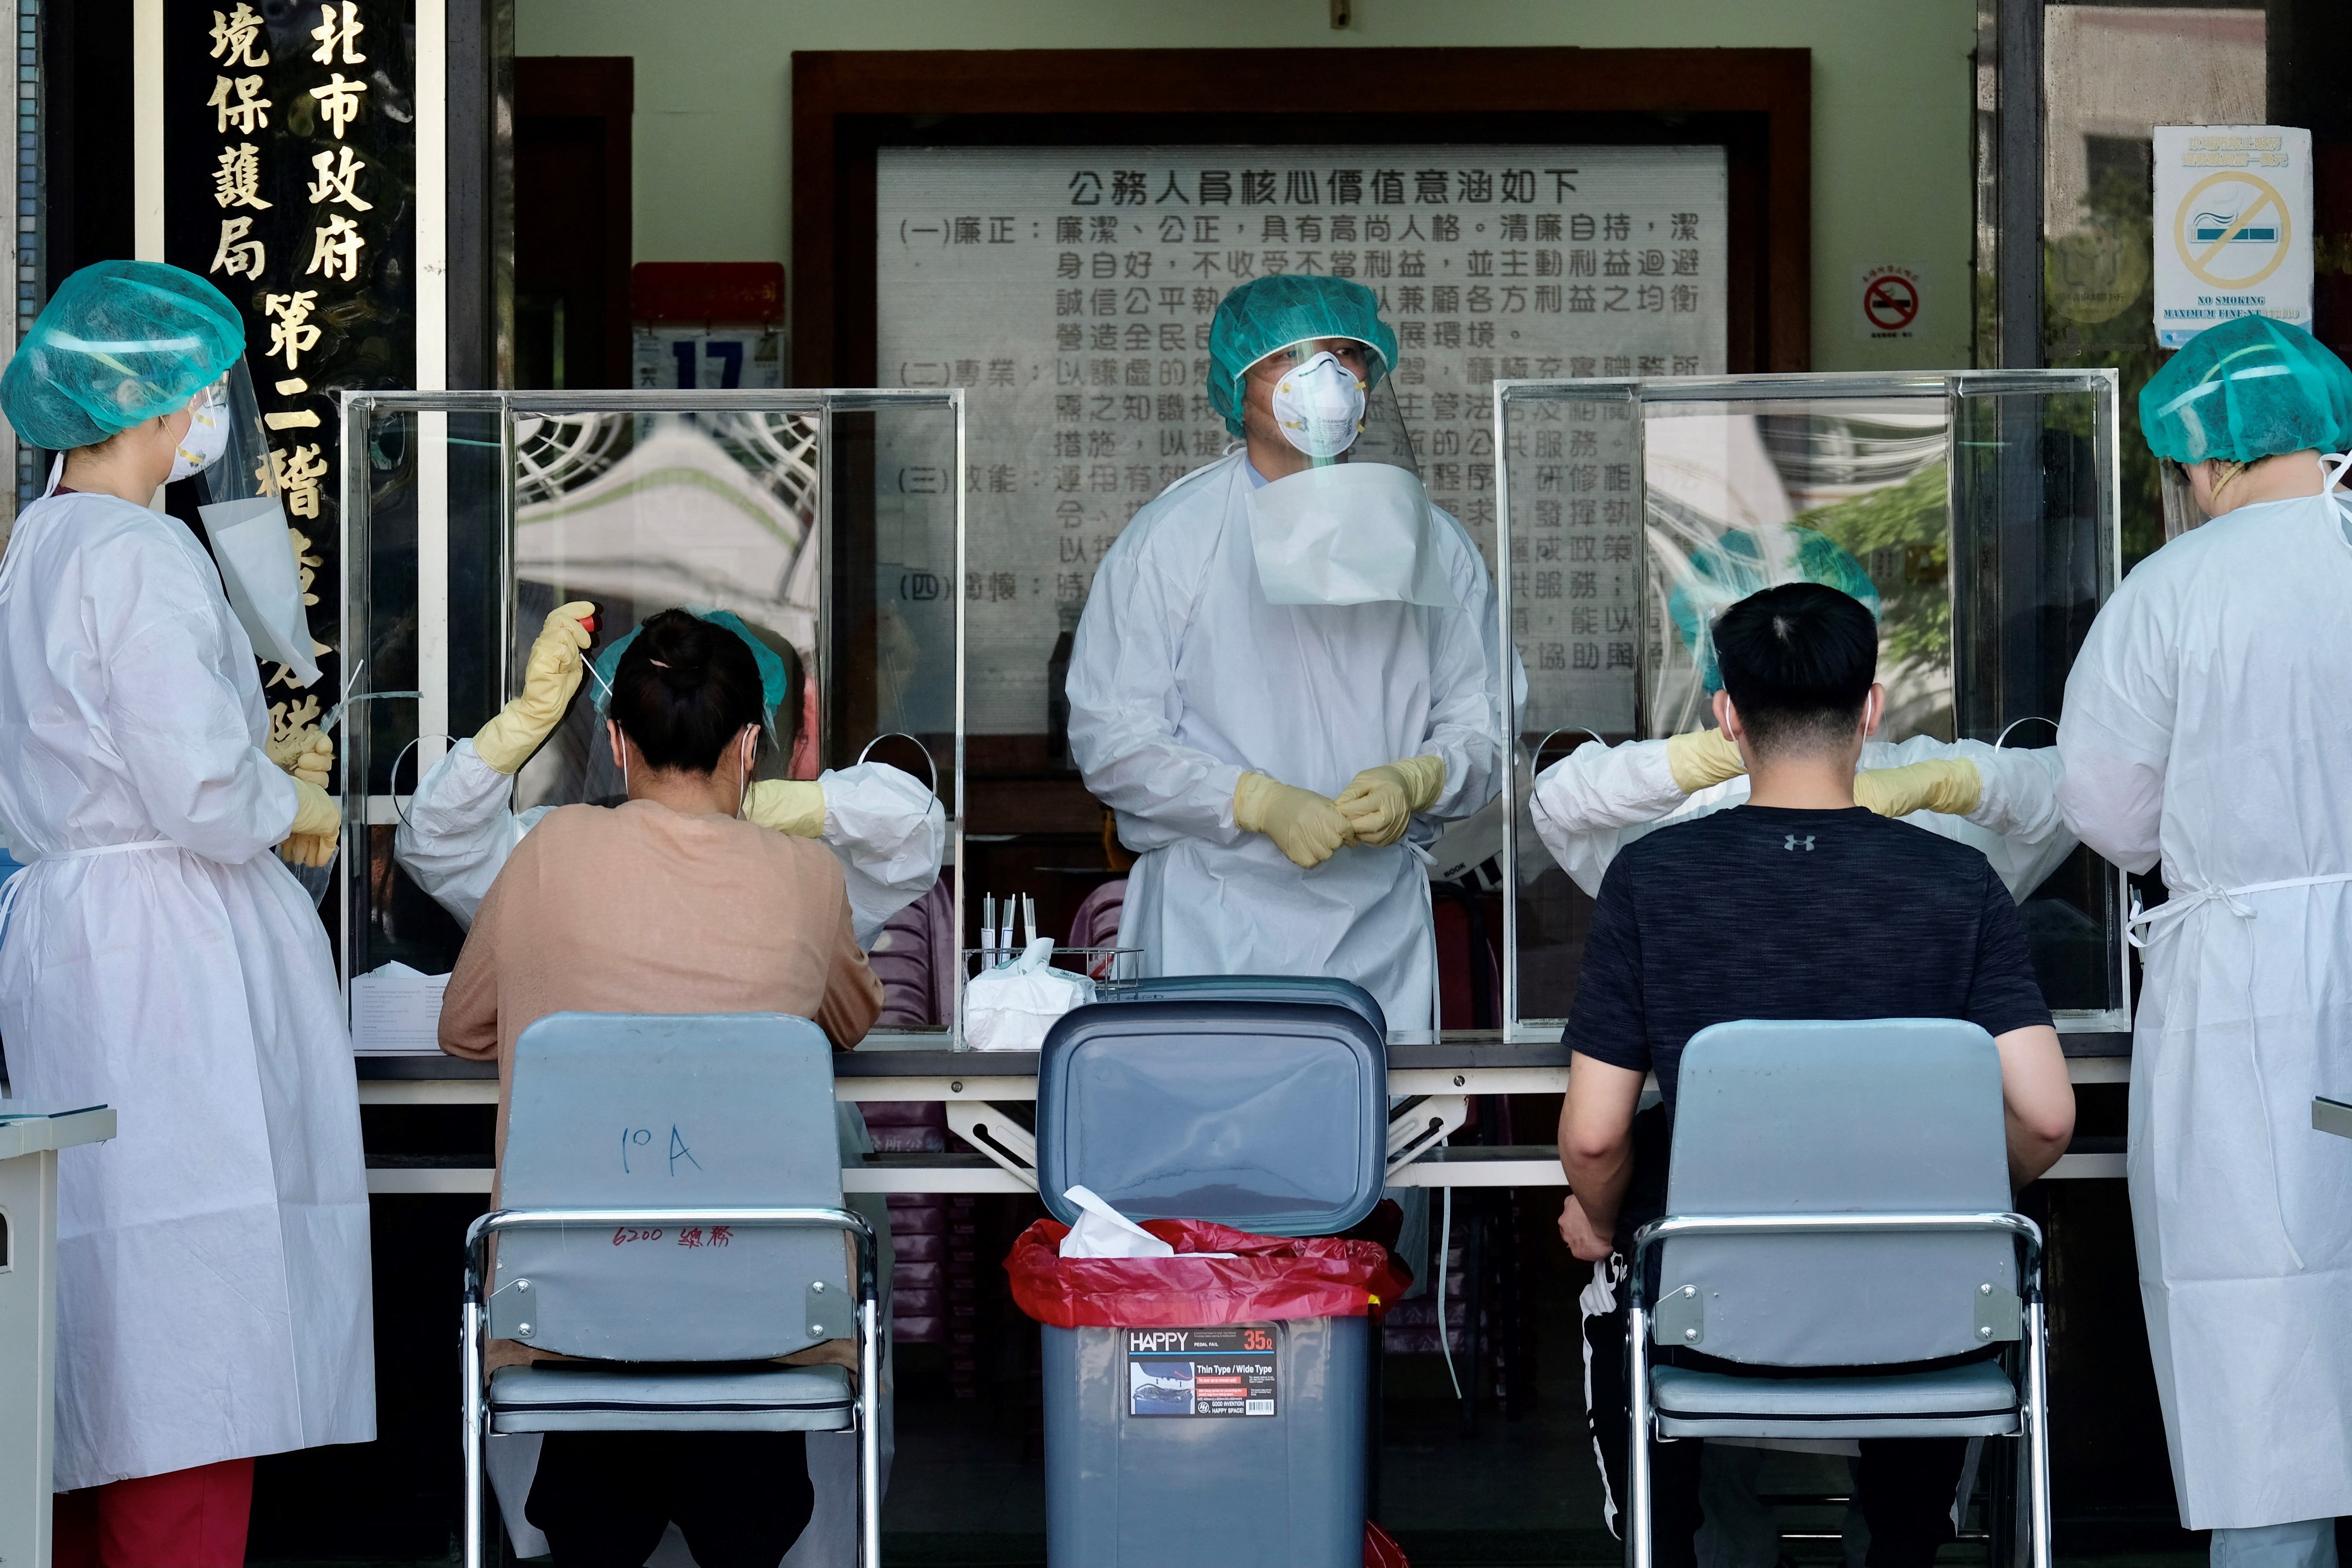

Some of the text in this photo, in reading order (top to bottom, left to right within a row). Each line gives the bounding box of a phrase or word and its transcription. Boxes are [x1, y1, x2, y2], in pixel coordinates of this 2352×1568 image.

[207, 2, 273, 281] 境保護局
[305, 0, 373, 281] 北市政府
[1068, 169, 1580, 205] 公務人員核心價值意涵如下
[2198, 296, 2266, 306] NO SMOKING
[2164, 309, 2216, 319] MAXIMUM
[672, 341, 743, 397] 17
[1444, 862, 1466, 878] BOOK
[669, 1123, 702, 1177] A
[613, 1226, 662, 1246] 6200
[1130, 1332, 1189, 1351] HAPPY
[1196, 1365, 1213, 1374] Thin
[1213, 1365, 1231, 1376] Type
[1236, 1364, 1254, 1374] Wide
[1254, 1364, 1273, 1375] Type
